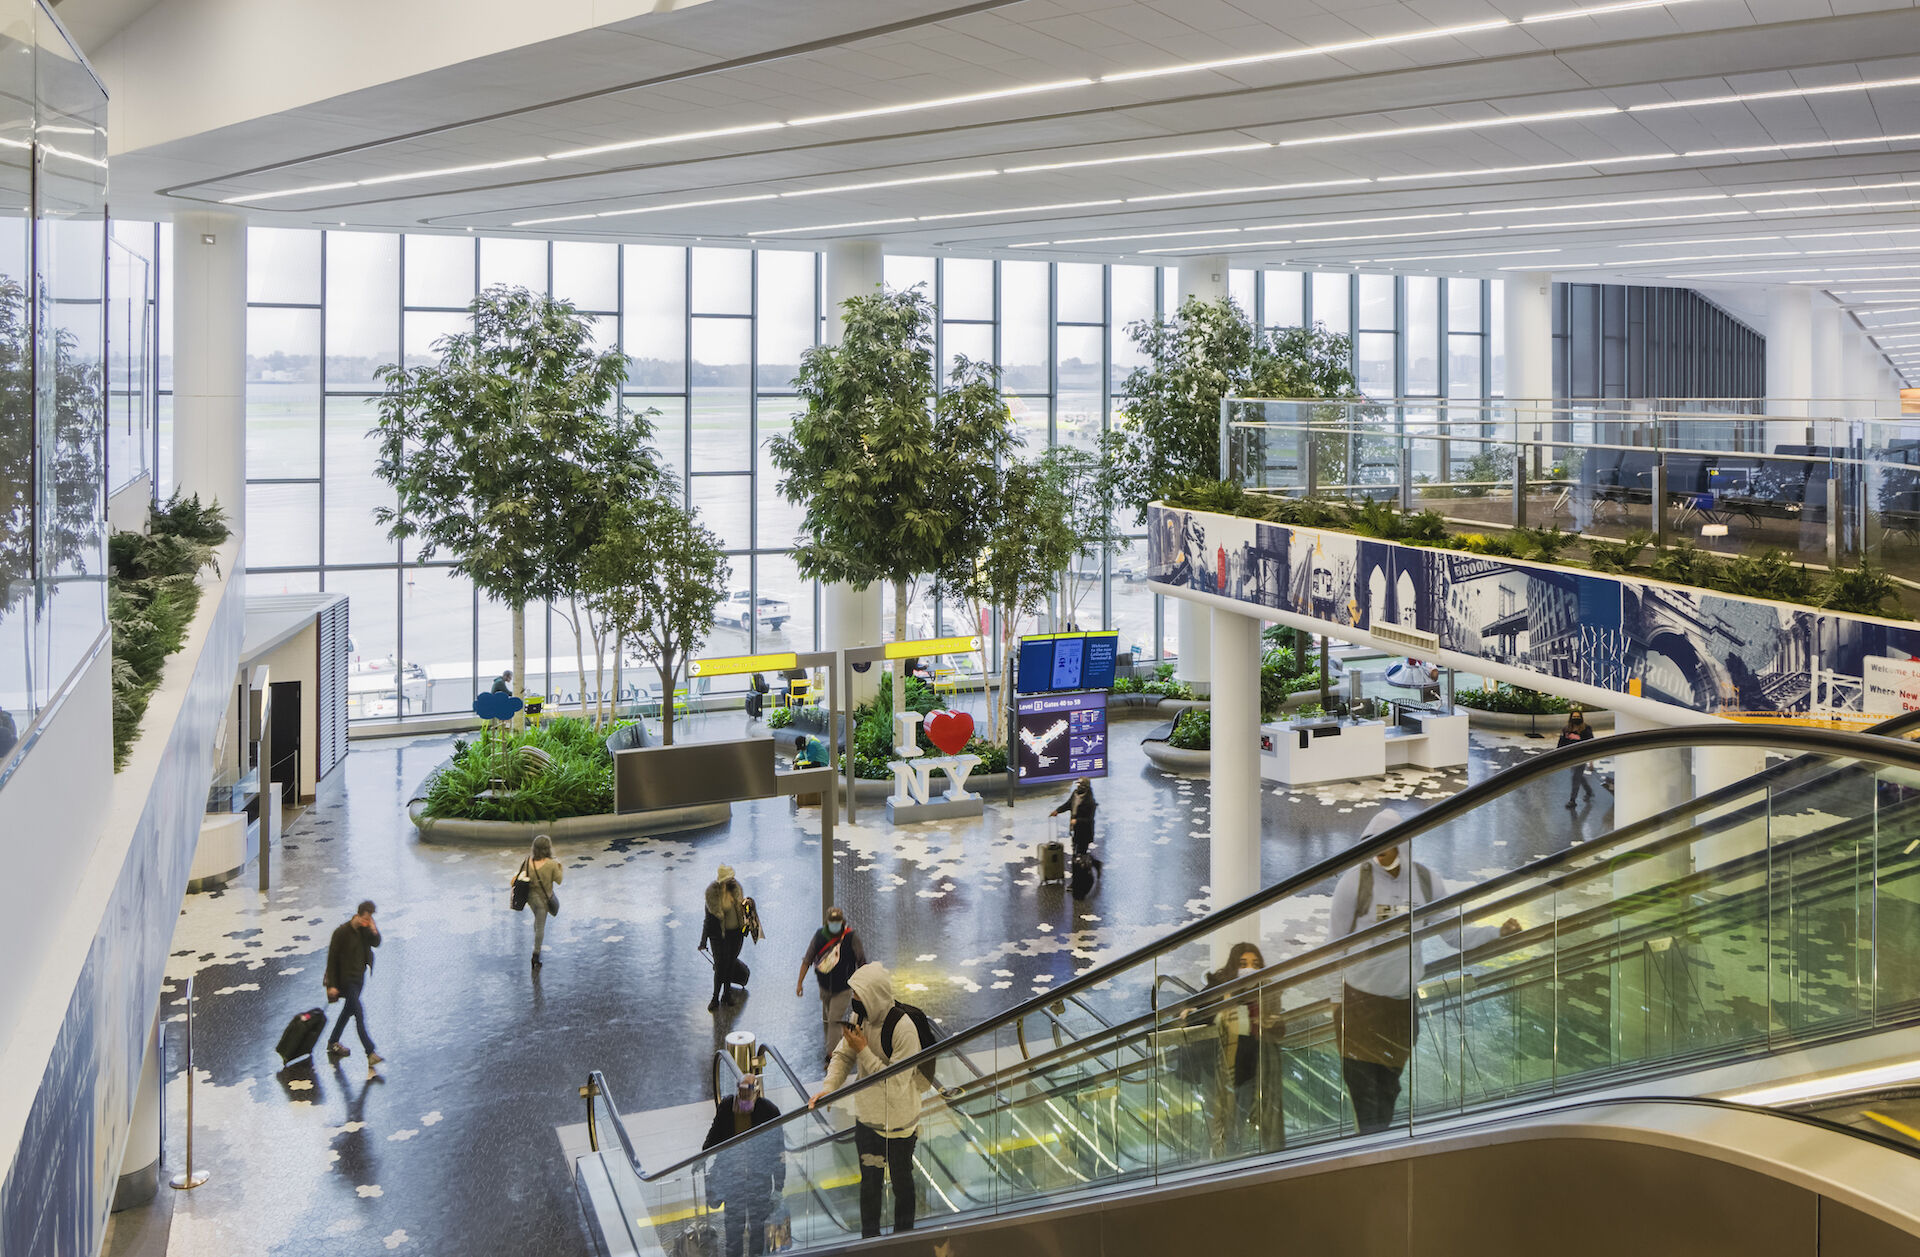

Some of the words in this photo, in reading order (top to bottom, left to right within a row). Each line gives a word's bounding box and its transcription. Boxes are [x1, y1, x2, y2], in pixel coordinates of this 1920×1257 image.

[1871, 664, 1907, 676] Welcme
[1870, 684, 1896, 696] Where
[1900, 690, 1918, 701] New
[895, 711, 925, 757] I
[886, 754, 983, 807] NY
